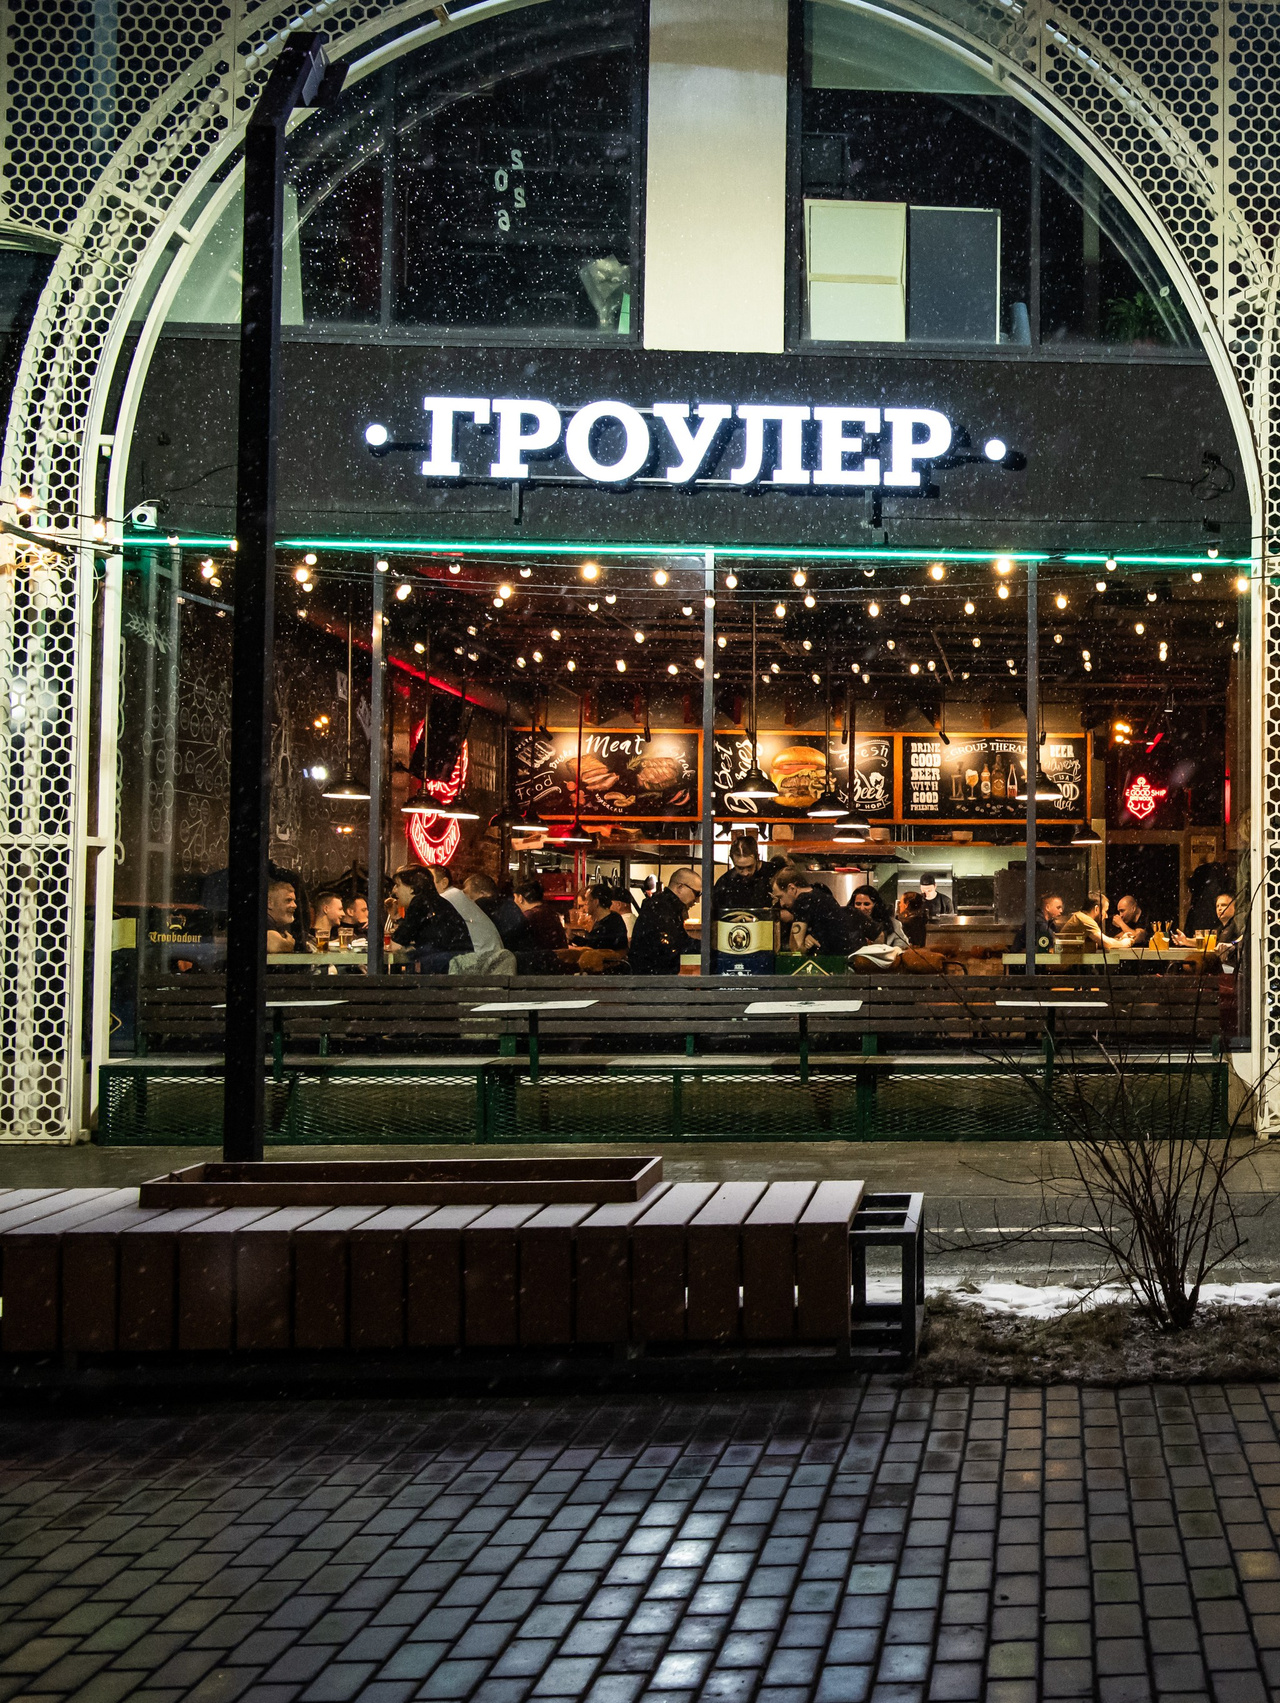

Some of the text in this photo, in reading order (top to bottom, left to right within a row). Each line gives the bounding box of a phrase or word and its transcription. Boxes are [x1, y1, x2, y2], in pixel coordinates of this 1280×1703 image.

[421, 395, 954, 488] ГРОУЛЕР
[585, 734, 646, 758] Meat
[910, 742, 941, 753] DRINK
[950, 742, 1028, 757] GROUP THERAP
[1049, 744, 1075, 758] BEER
[839, 745, 889, 766] Fesh
[910, 753, 941, 767] GOOD
[714, 740, 733, 789] Best
[910, 767, 941, 781] BEER
[910, 781, 939, 791] WITH
[1057, 783, 1080, 801] OD
[1130, 789, 1151, 797] GOOD
[1151, 789, 1167, 797] SHIP
[912, 791, 939, 804] GOOD
[148, 931, 202, 943] Troubadour
